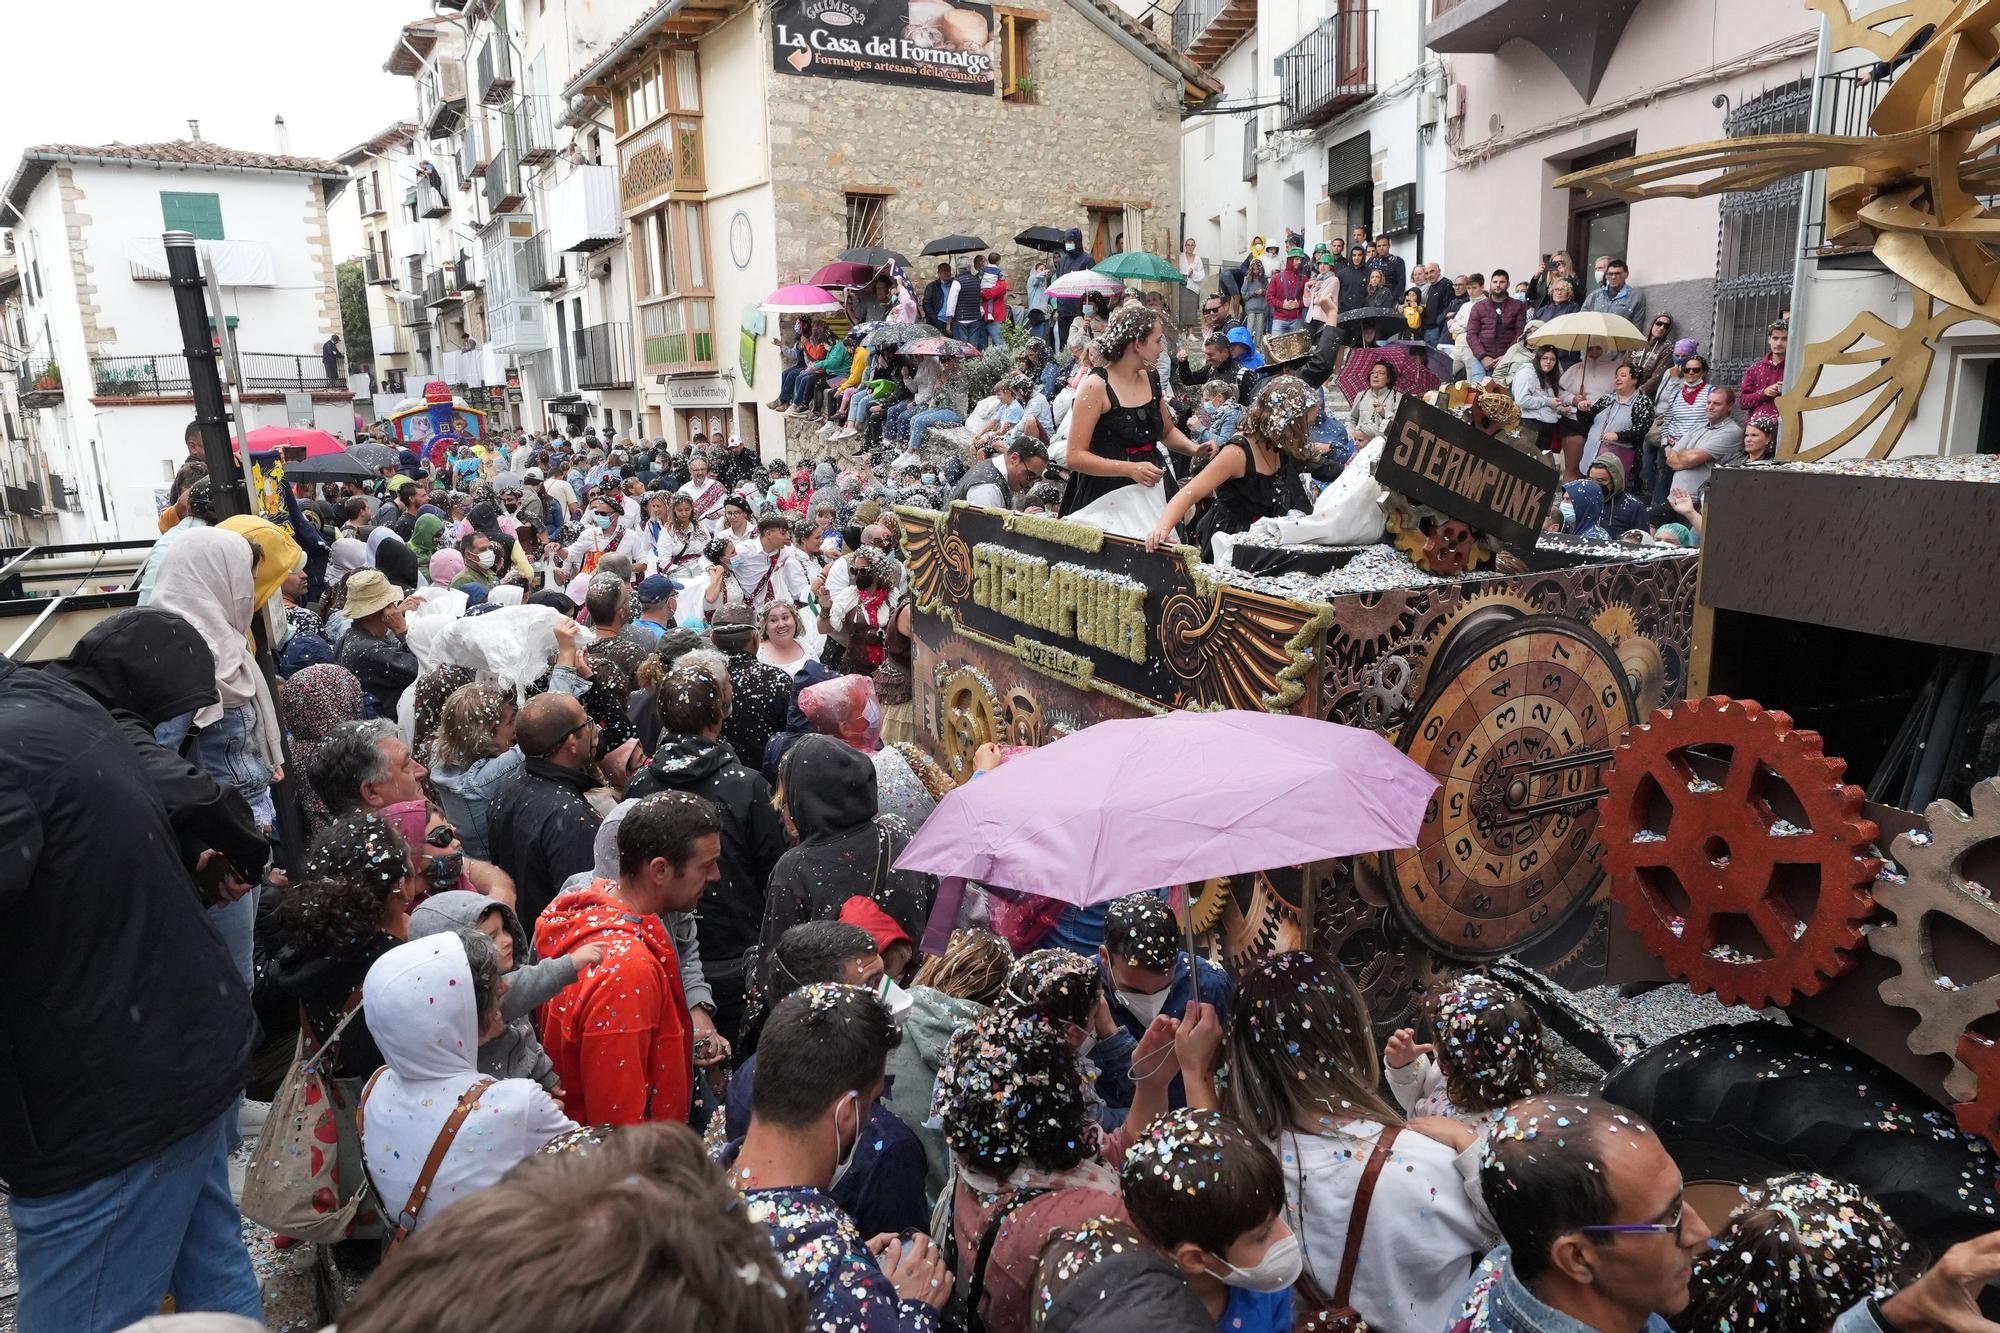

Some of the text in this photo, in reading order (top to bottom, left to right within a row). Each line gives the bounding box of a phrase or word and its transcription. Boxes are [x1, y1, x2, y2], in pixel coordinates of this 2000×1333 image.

[777, 24, 990, 75] La Casa del Formatge
[815, 53, 988, 83] Formatges artesans de la comarca
[671, 385, 727, 399] La Casa del Formatge
[1393, 420, 1547, 529] STEAMPUNK
[1488, 649, 1508, 672] 8
[1551, 641, 1571, 660] 7
[1490, 678, 1511, 698] 4
[1542, 673, 1561, 693] 3
[1602, 684, 1617, 708] 6
[1496, 706, 1516, 729] 3
[1531, 704, 1551, 724] 2
[1581, 704, 1598, 730] 2
[1440, 730, 1462, 756] 5
[1523, 737, 1540, 755] 4
[1561, 727, 1576, 749] 1
[1460, 743, 1478, 768] 4
[1500, 740, 1519, 760] 5
[1450, 791, 1464, 819] 5
[1515, 825, 1534, 845] 0
[1552, 815, 1569, 838] 9
[1436, 859, 1451, 885] 7
[1485, 862, 1504, 879] 7
[1519, 849, 1538, 872] 8
[1410, 879, 1428, 903] 1
